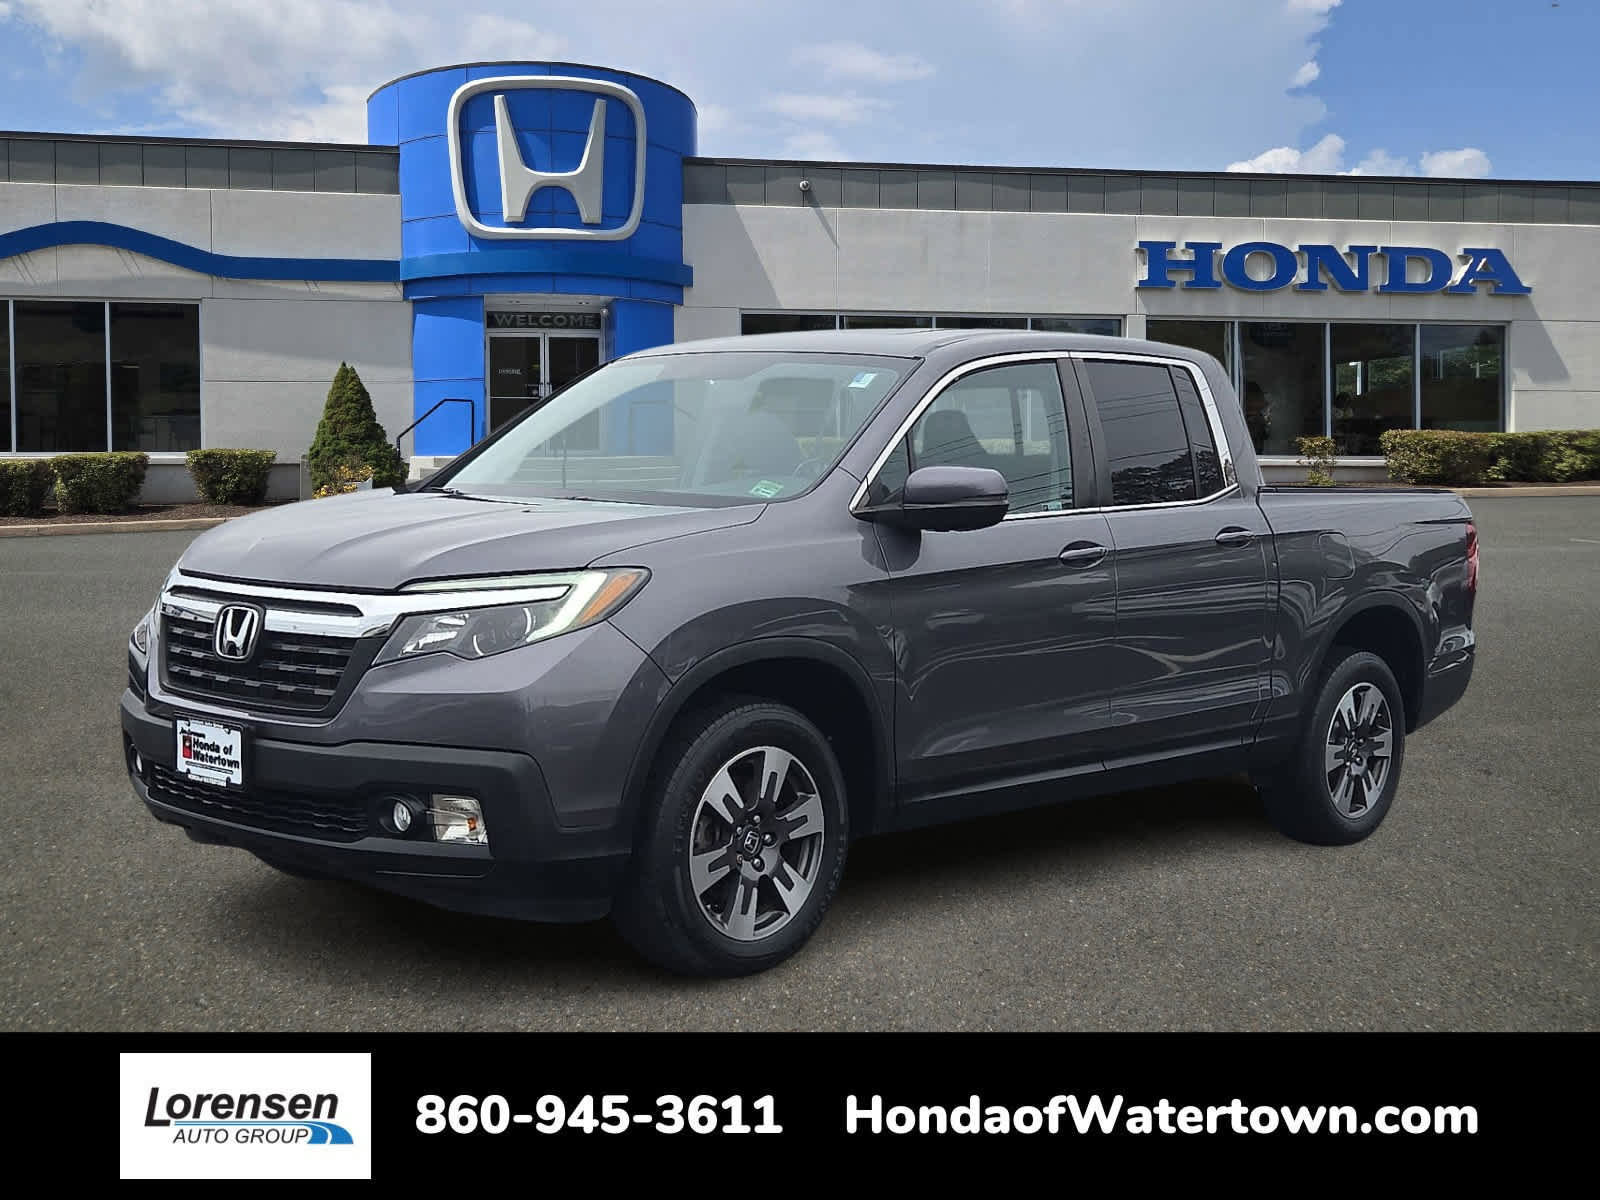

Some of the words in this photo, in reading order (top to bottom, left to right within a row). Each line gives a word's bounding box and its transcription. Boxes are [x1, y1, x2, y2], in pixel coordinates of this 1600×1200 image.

[1137, 240, 1532, 294] HONDA
[494, 313, 598, 328] WELCOME
[193, 737, 220, 754] Honda
[223, 745, 233, 756] of
[193, 750, 240, 769] Watertown
